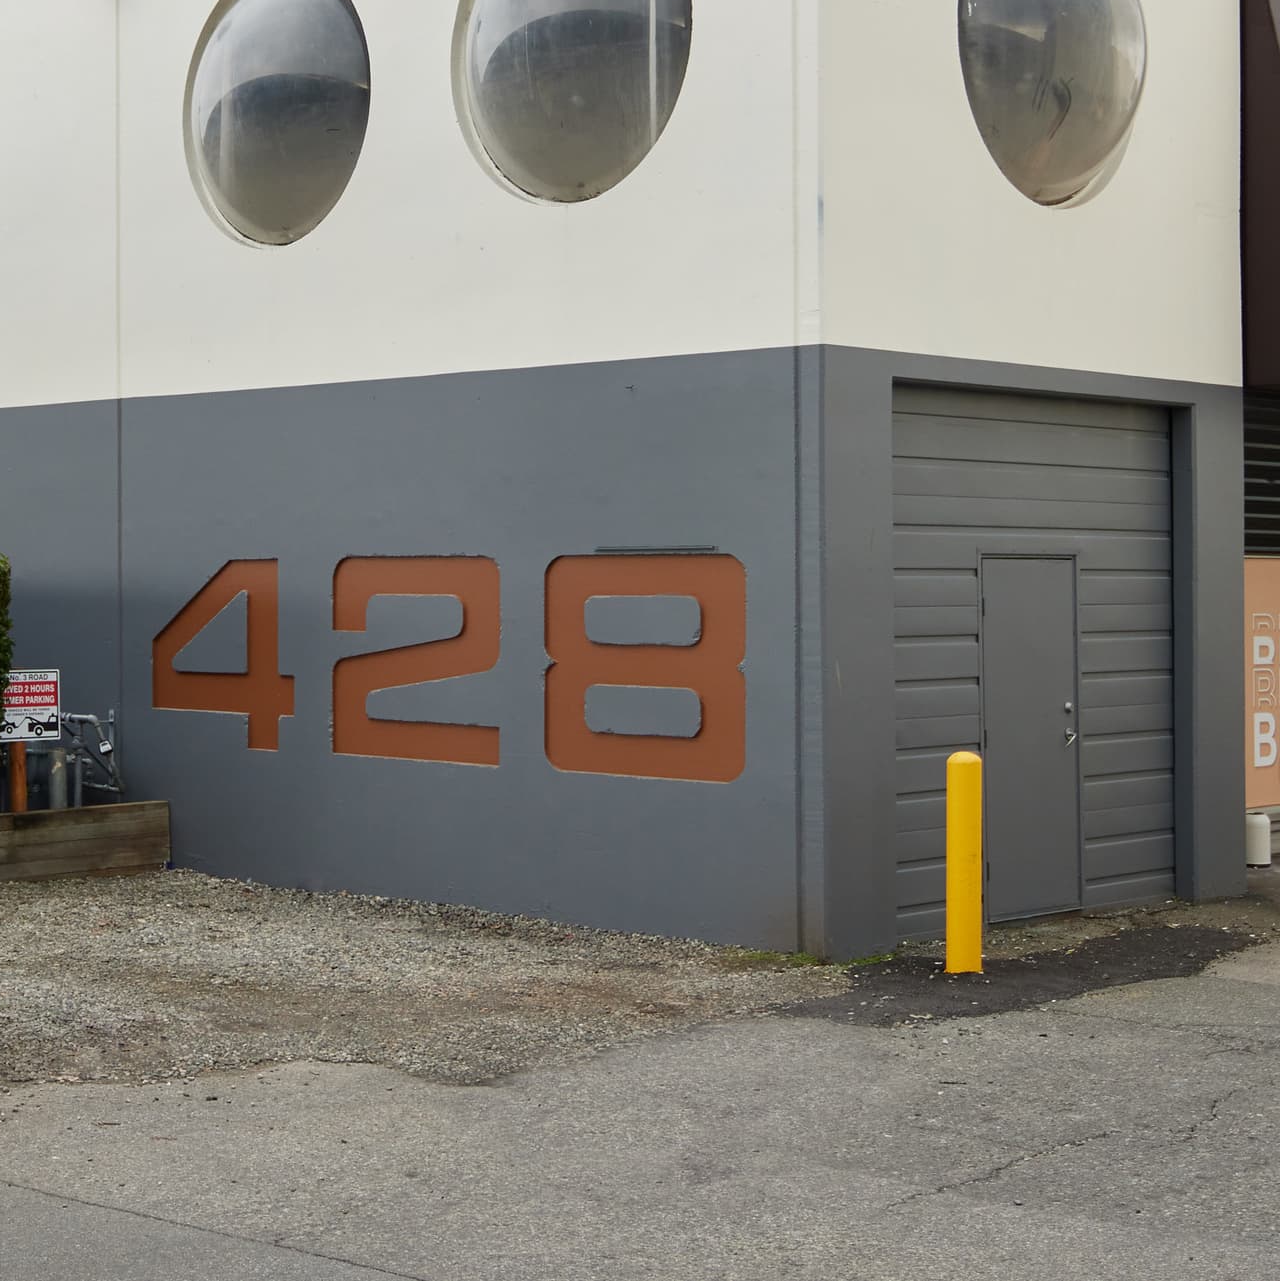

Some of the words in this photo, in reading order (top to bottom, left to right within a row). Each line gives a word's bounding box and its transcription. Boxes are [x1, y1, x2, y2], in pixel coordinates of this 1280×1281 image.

[152, 552, 747, 784] 428
[28, 673, 49, 681] ROAD
[24, 685, 29, 693] 2
[30, 684, 55, 693] HOURS
[25, 695, 55, 704] PARKING
